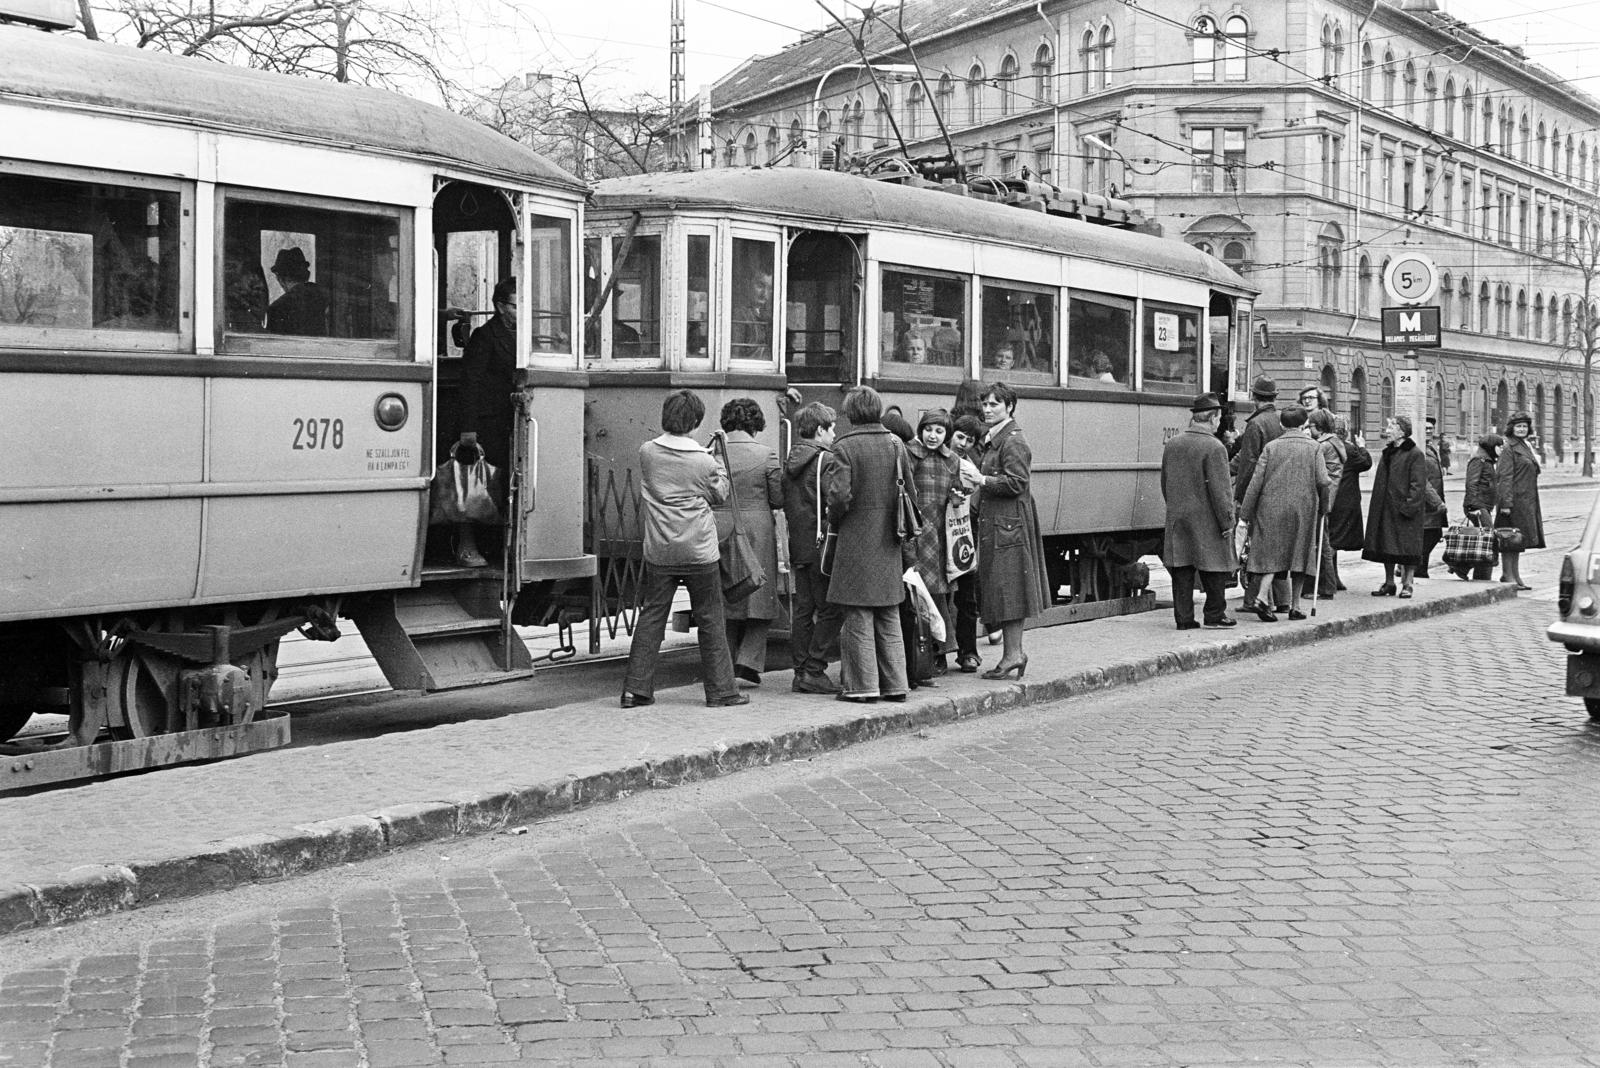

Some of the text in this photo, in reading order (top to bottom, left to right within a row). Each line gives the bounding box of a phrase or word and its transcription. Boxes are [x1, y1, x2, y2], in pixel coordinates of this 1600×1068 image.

[1401, 271, 1423, 289] 5 km
[1400, 311, 1421, 332] M
[1159, 326, 1167, 341] 23
[292, 417, 344, 450] 2978
[366, 448, 373, 458] NE
[401, 448, 410, 458] FEL
